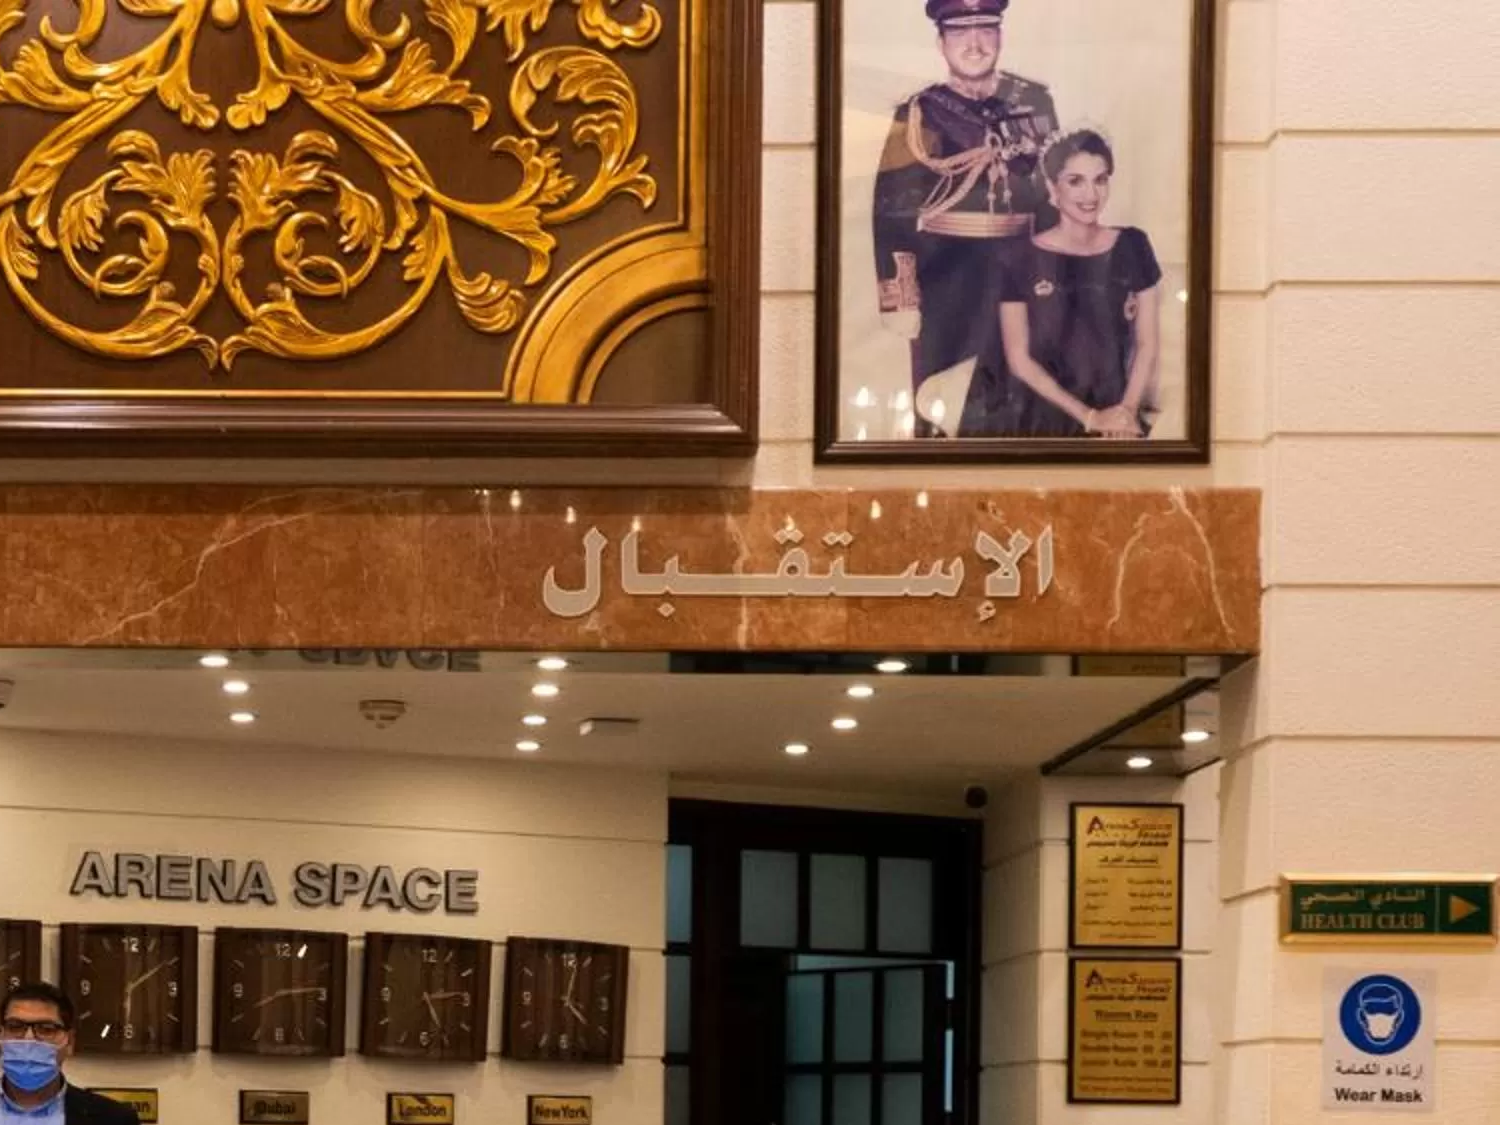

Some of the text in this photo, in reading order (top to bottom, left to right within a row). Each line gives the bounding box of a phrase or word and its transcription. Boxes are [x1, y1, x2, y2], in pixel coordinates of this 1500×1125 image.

[542, 522, 1055, 623] الإستقبال
[70, 850, 481, 916] ARENA SPACE
[1301, 912, 1426, 930] HEALTH CLUB
[121, 936, 140, 953] 12
[421, 947, 437, 963] 12
[1334, 1087, 1423, 1103] Wear Mask
[398, 1102, 447, 1117] London
